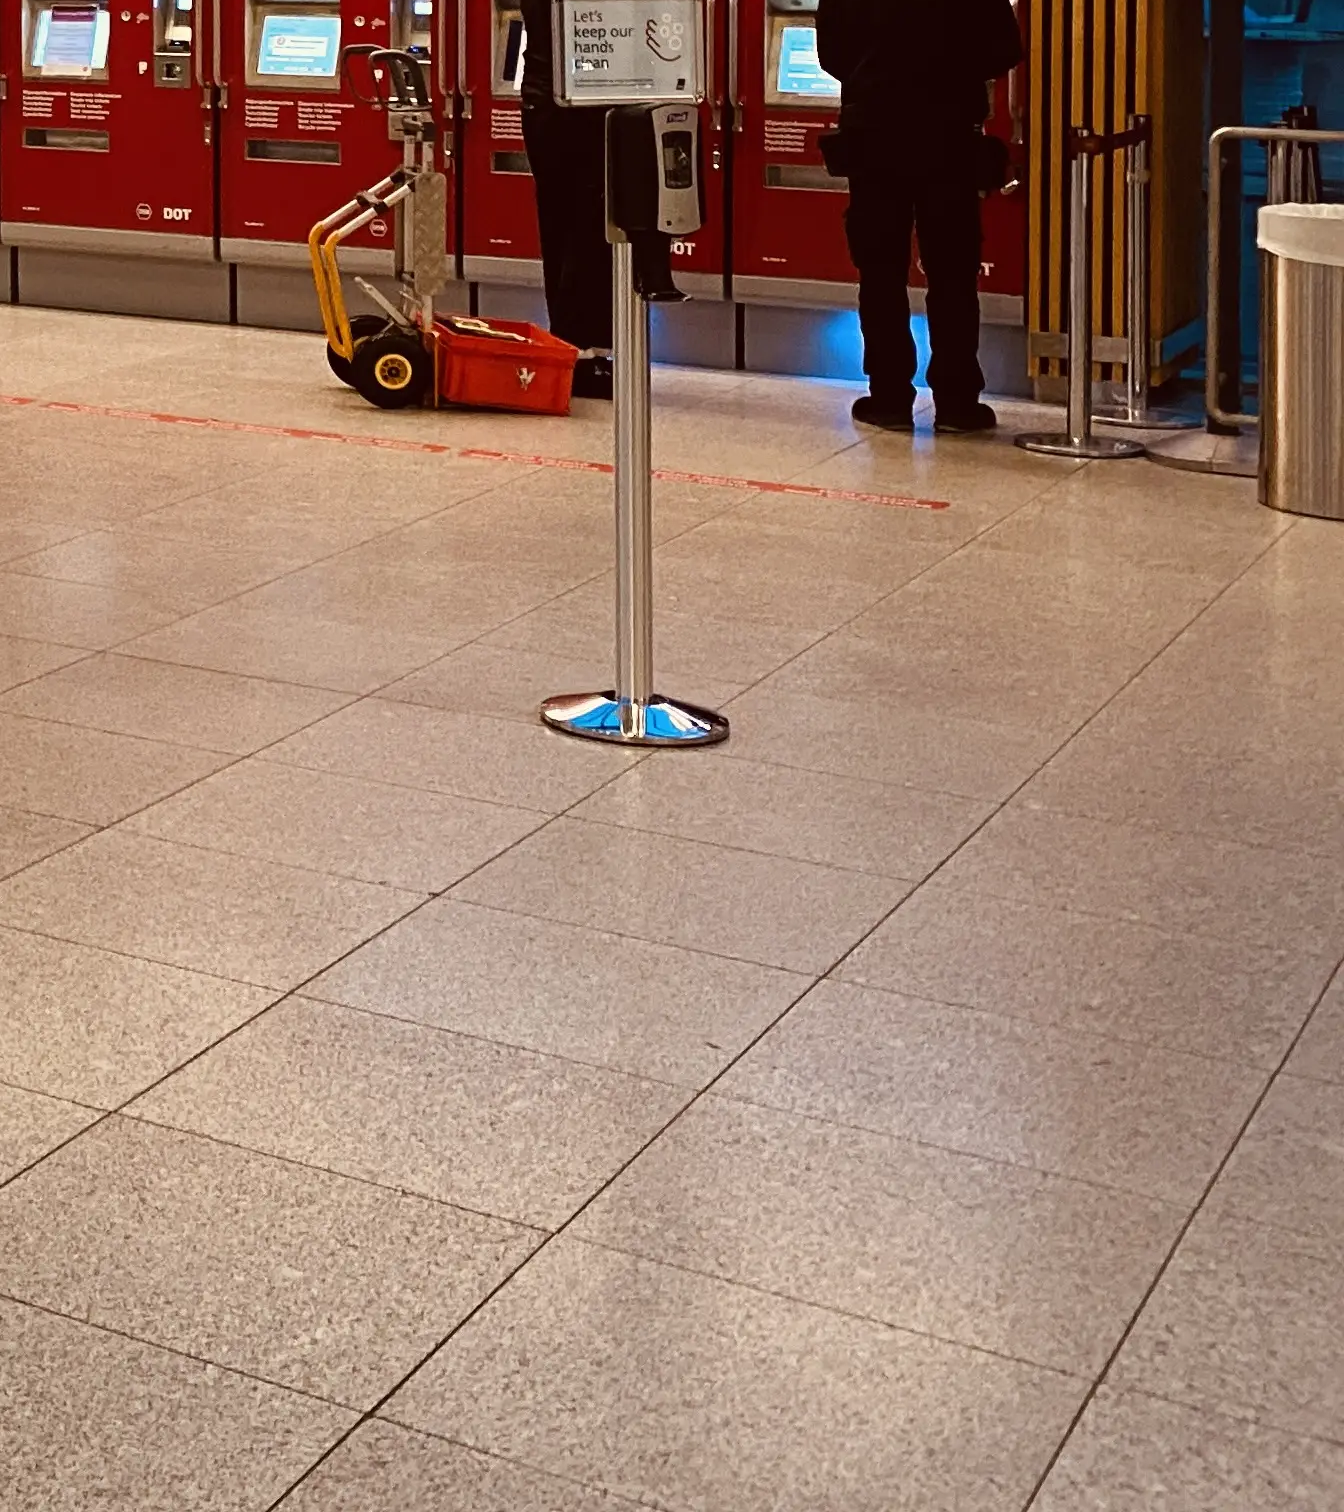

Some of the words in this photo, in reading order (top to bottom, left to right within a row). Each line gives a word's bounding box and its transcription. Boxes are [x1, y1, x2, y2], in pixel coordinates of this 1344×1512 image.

[574, 25, 607, 41] keep
[610, 27, 633, 38] our
[574, 40, 614, 54] hands
[162, 206, 193, 221] DOT
[670, 241, 696, 256] OT
